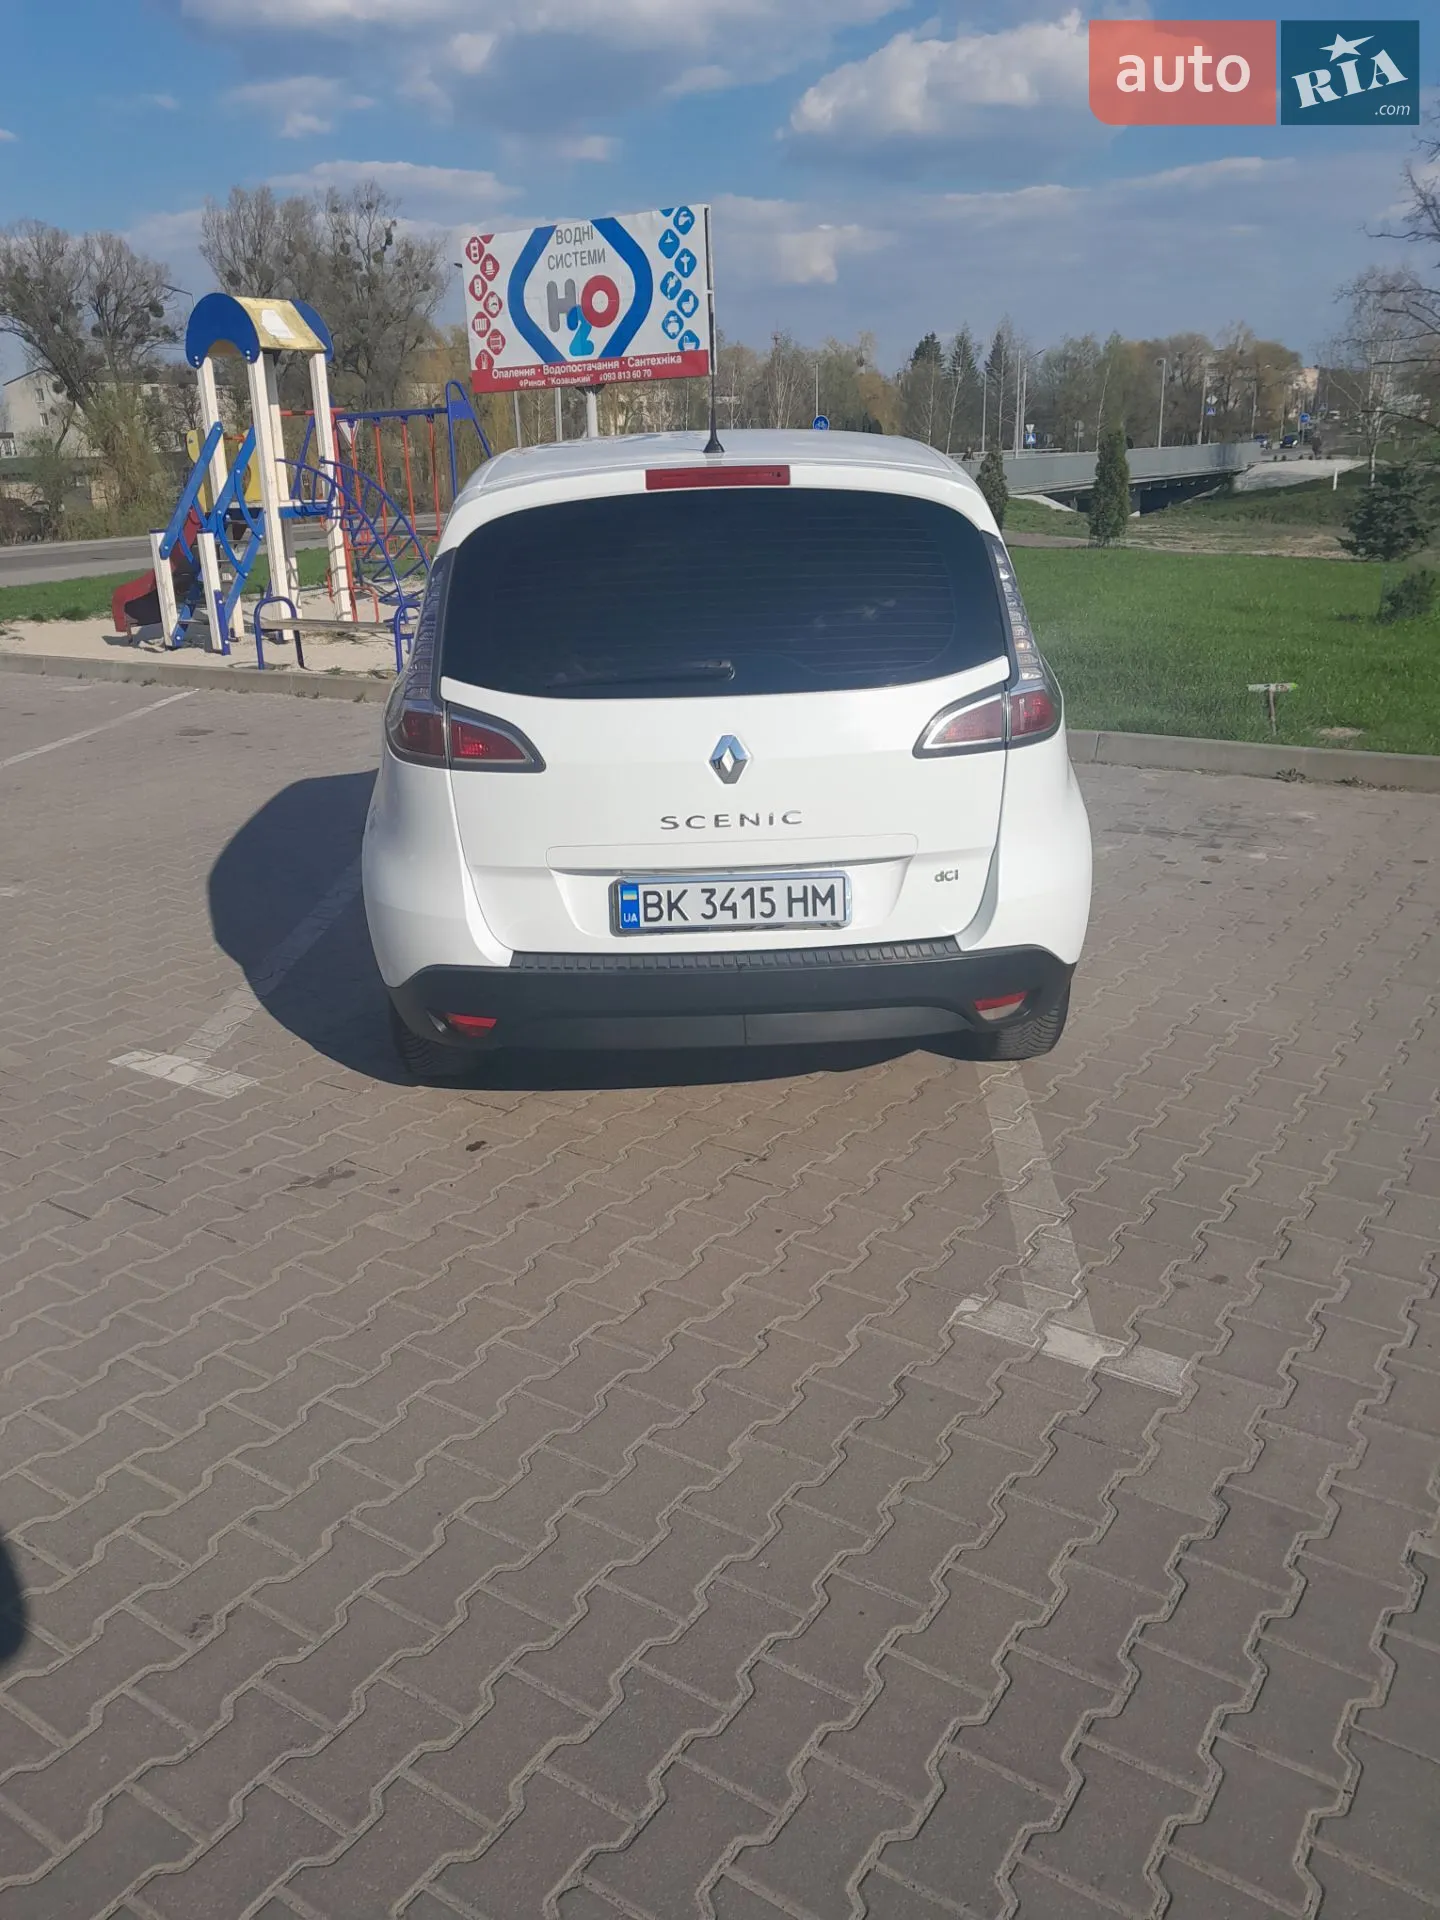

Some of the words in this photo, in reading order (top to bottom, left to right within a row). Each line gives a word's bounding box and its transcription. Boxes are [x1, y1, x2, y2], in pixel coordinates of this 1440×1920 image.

[555, 225, 594, 246] ВОДНІ
[547, 248, 606, 271] СИСТЕМИ
[492, 367, 536, 379] Опалення
[543, 360, 620, 375] Водопостачання
[627, 353, 682, 367] Сантехніка
[523, 378, 546, 387] Ринок
[602, 372, 616, 381] 093
[617, 370, 631, 380] 813
[643, 368, 652, 378] 70
[643, 889, 689, 923] BK
[700, 886, 777, 920] 3415
[787, 884, 836, 918] HM
[623, 912, 638, 923] UA
